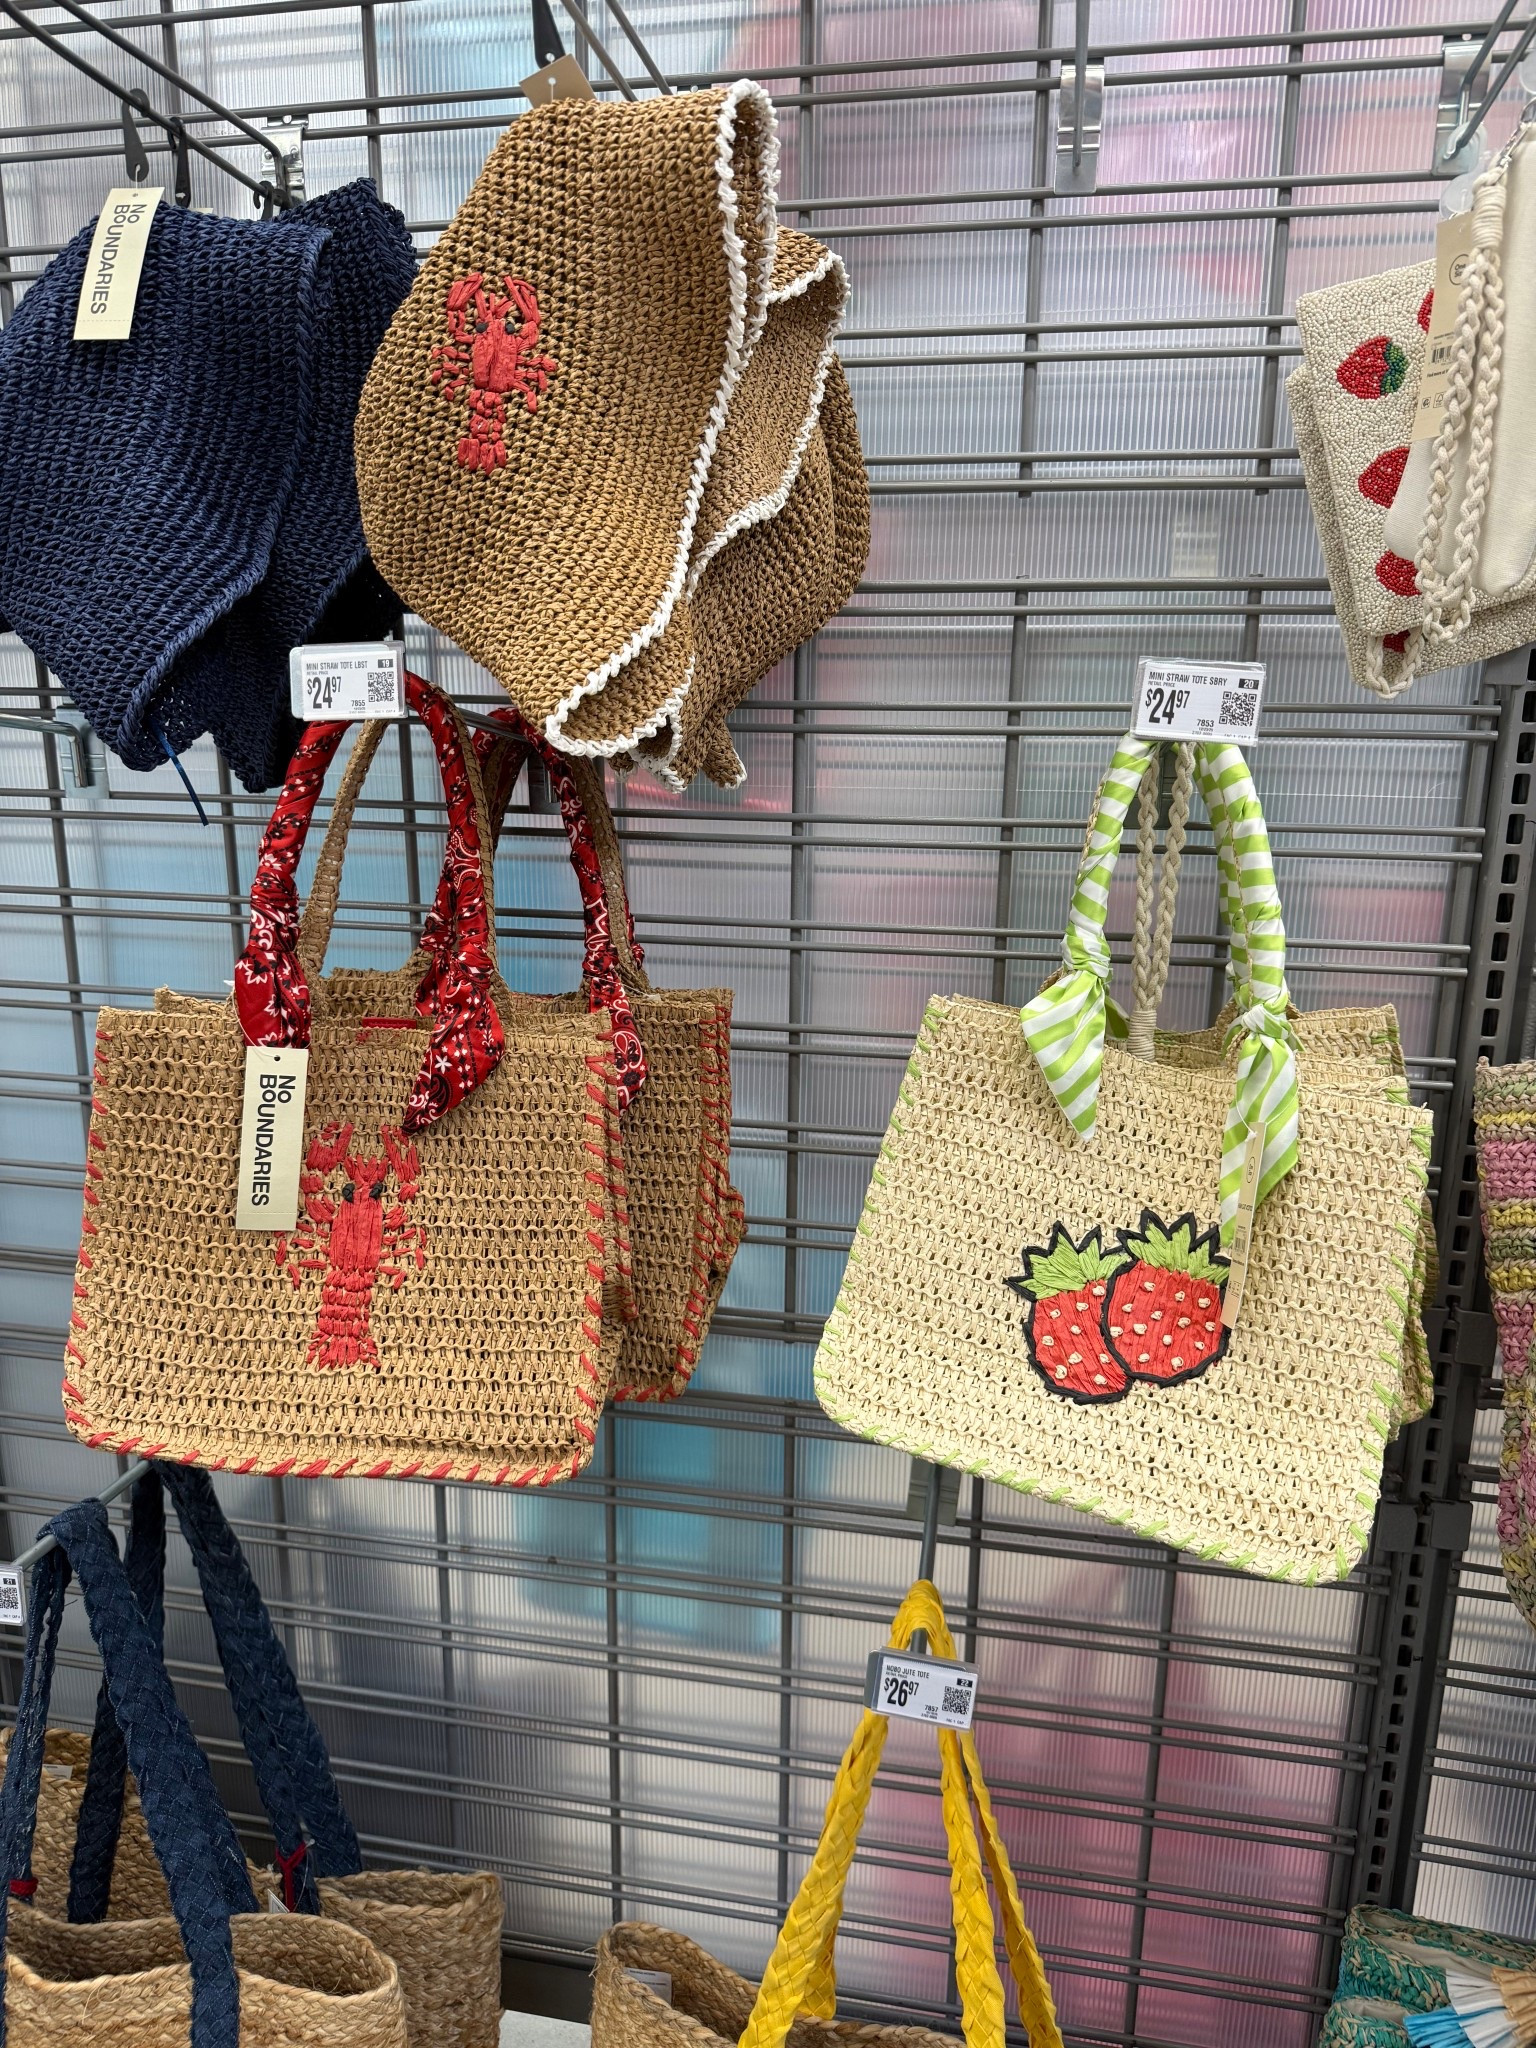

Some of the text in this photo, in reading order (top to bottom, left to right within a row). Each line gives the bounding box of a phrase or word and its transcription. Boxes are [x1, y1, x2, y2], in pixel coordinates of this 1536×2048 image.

[127, 204, 148, 224] NO
[90, 204, 131, 315] BOUNDARIES
[306, 660, 368, 671] MINI STRAW TOTE LBST
[382, 659, 390, 668] 19
[1149, 671, 1228, 686] MINI STRAW TOTE SBRY
[1243, 680, 1254, 689] 20
[351, 699, 366, 707] 7855
[1196, 718, 1215, 728] 7853
[277, 1075, 297, 1104] NO
[251, 1073, 278, 1207] BOUNDARIES
[902, 1668, 916, 1677] JUTE
[917, 1670, 930, 1679] TOTE
[960, 1678, 969, 1687] 22
[924, 1704, 939, 1713] 7857
